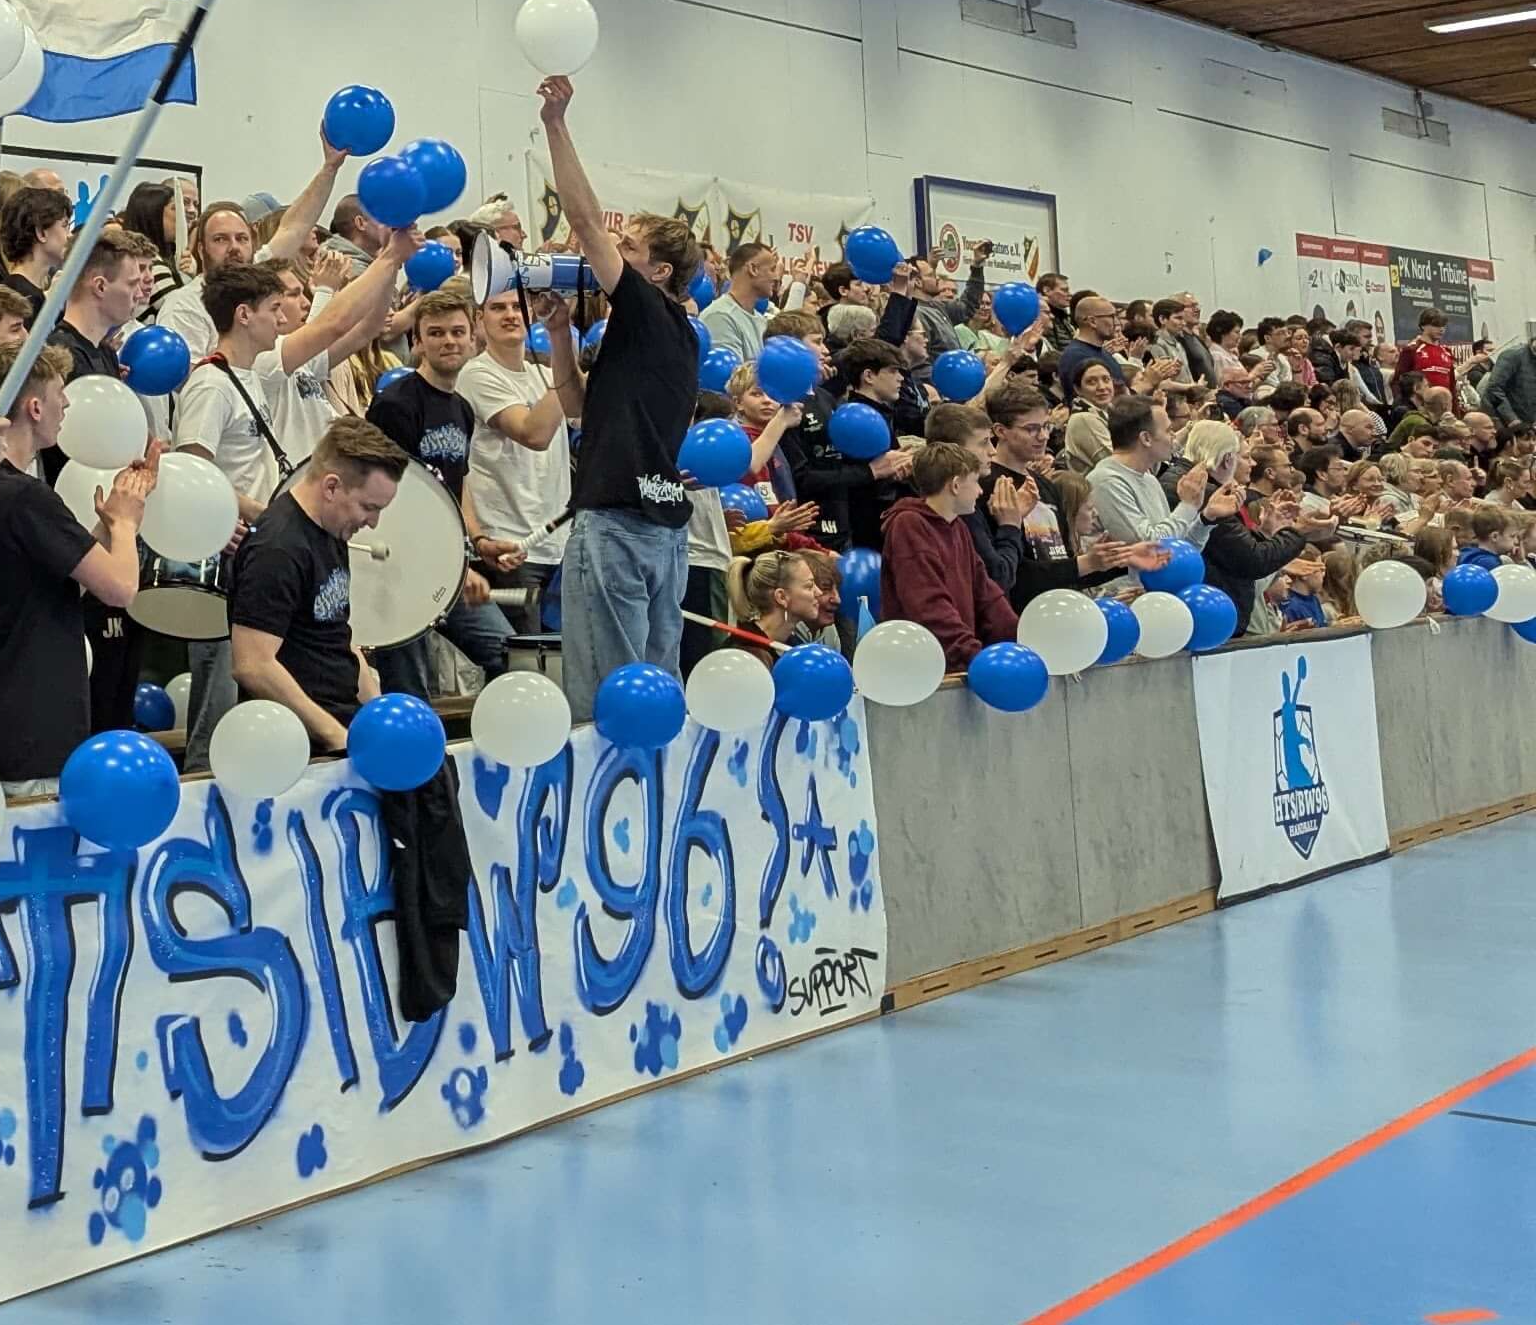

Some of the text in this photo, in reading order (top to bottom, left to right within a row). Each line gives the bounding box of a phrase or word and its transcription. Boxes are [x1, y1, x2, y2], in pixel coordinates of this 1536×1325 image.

[788, 222, 814, 244] TSV
[1398, 256, 1410, 278] PK
[1411, 258, 1432, 281] Nord
[1437, 261, 1468, 285] Tribüne
[102, 617, 124, 638] JK
[788, 947, 878, 1016] SUPPORT
